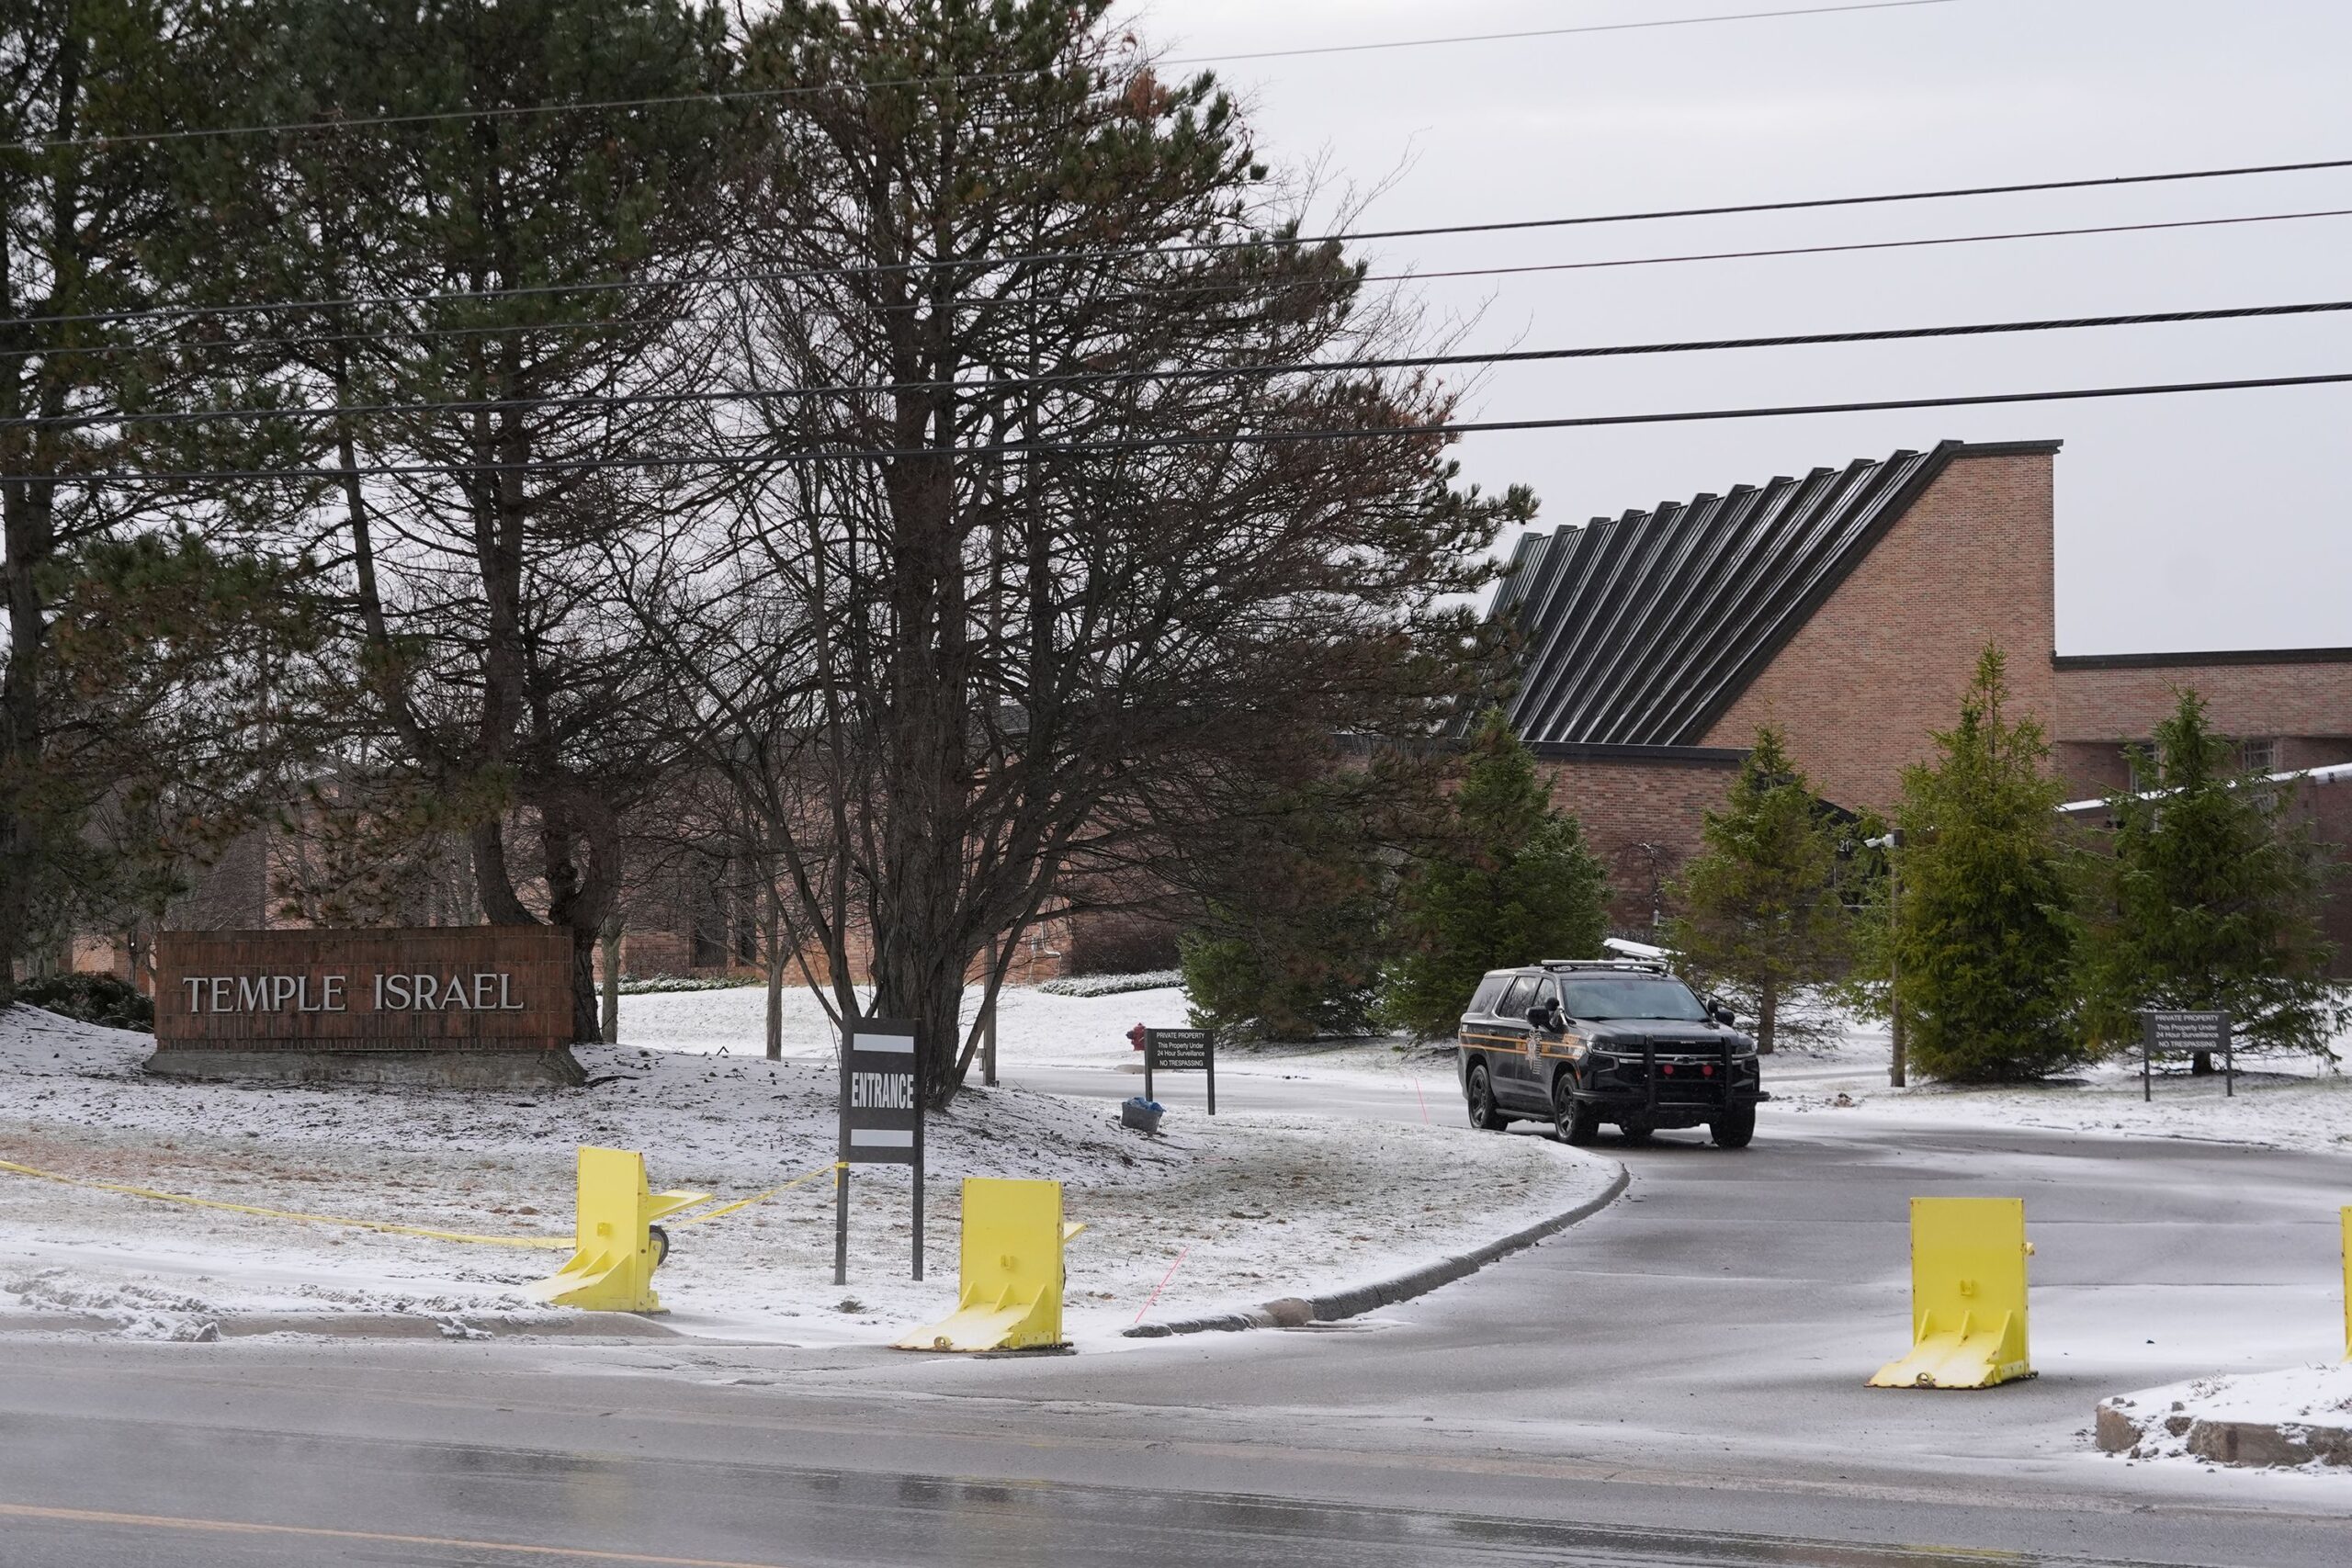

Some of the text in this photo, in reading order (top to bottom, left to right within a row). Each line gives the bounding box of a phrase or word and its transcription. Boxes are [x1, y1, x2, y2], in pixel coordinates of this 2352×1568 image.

[183, 974, 524, 1013] TEMPLE ISRAEL
[852, 1072, 914, 1110] ENTRANCE
